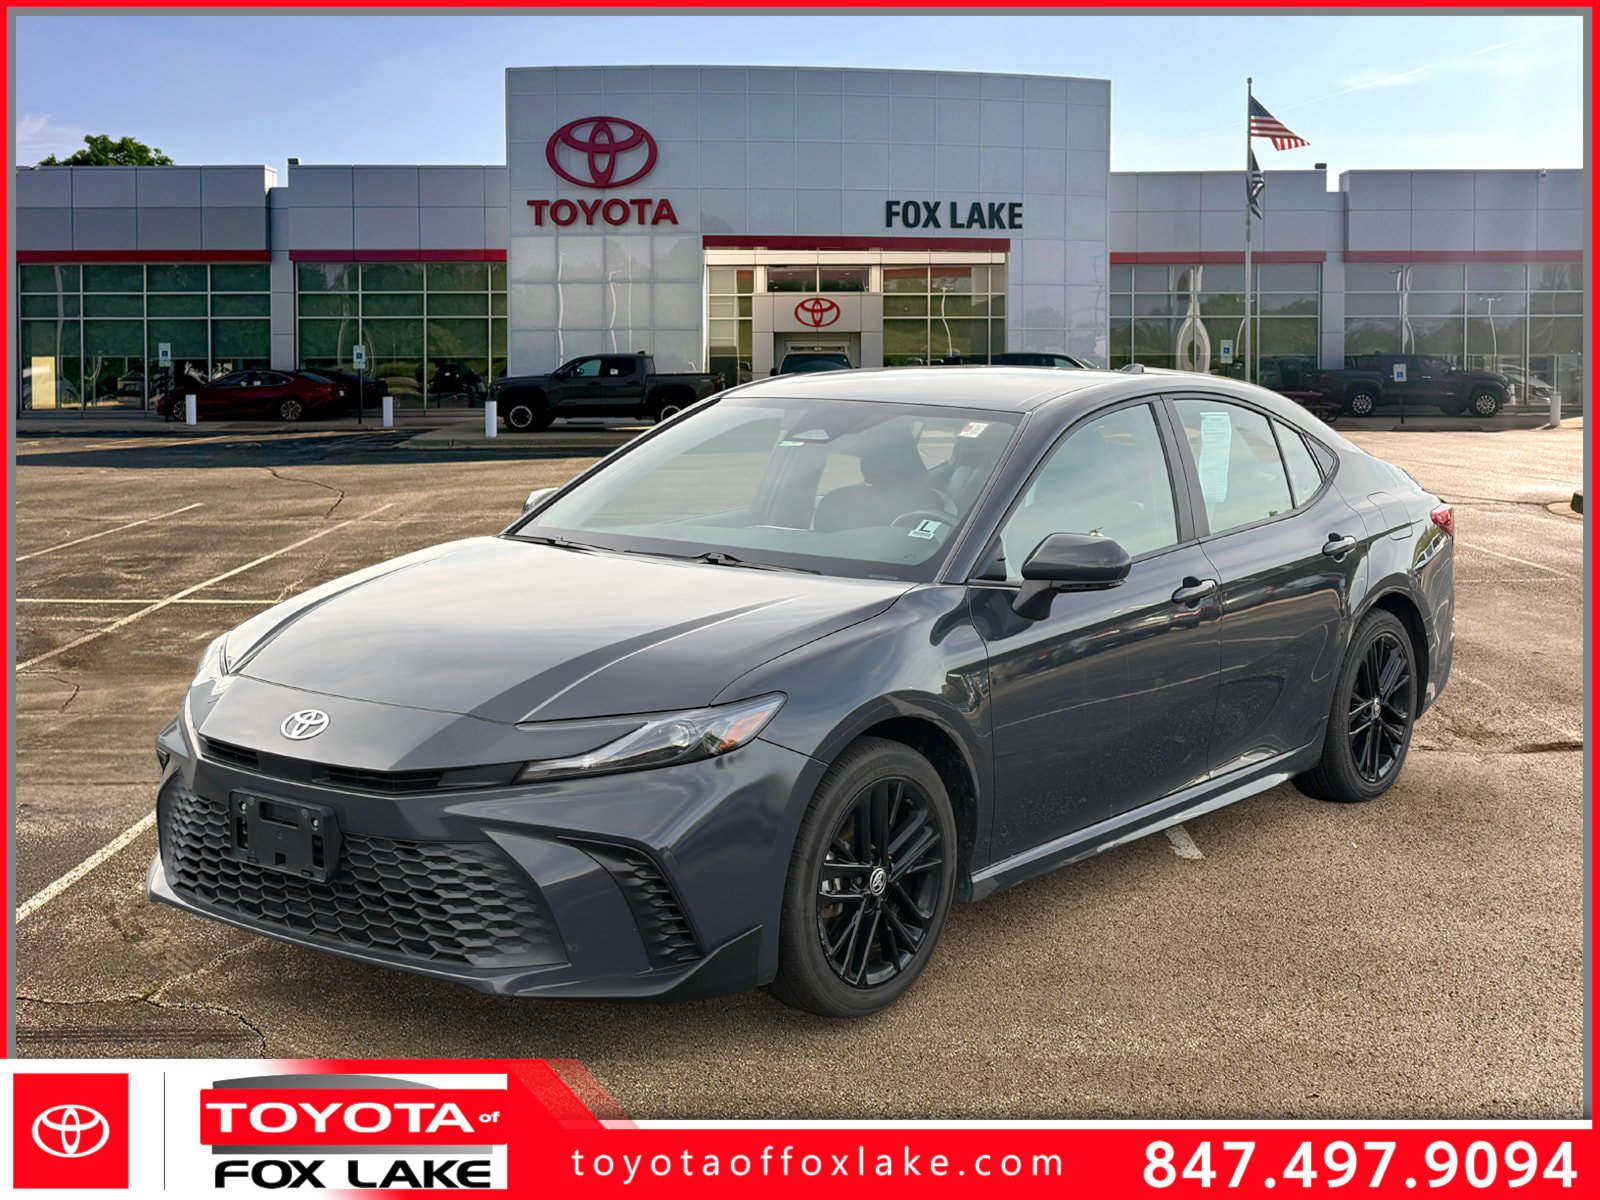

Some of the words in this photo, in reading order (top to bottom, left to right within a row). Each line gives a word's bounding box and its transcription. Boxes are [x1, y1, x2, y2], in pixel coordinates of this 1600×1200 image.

[527, 198, 679, 226] TOYOTA
[885, 200, 942, 229] FOX
[949, 201, 1024, 230] LAKE
